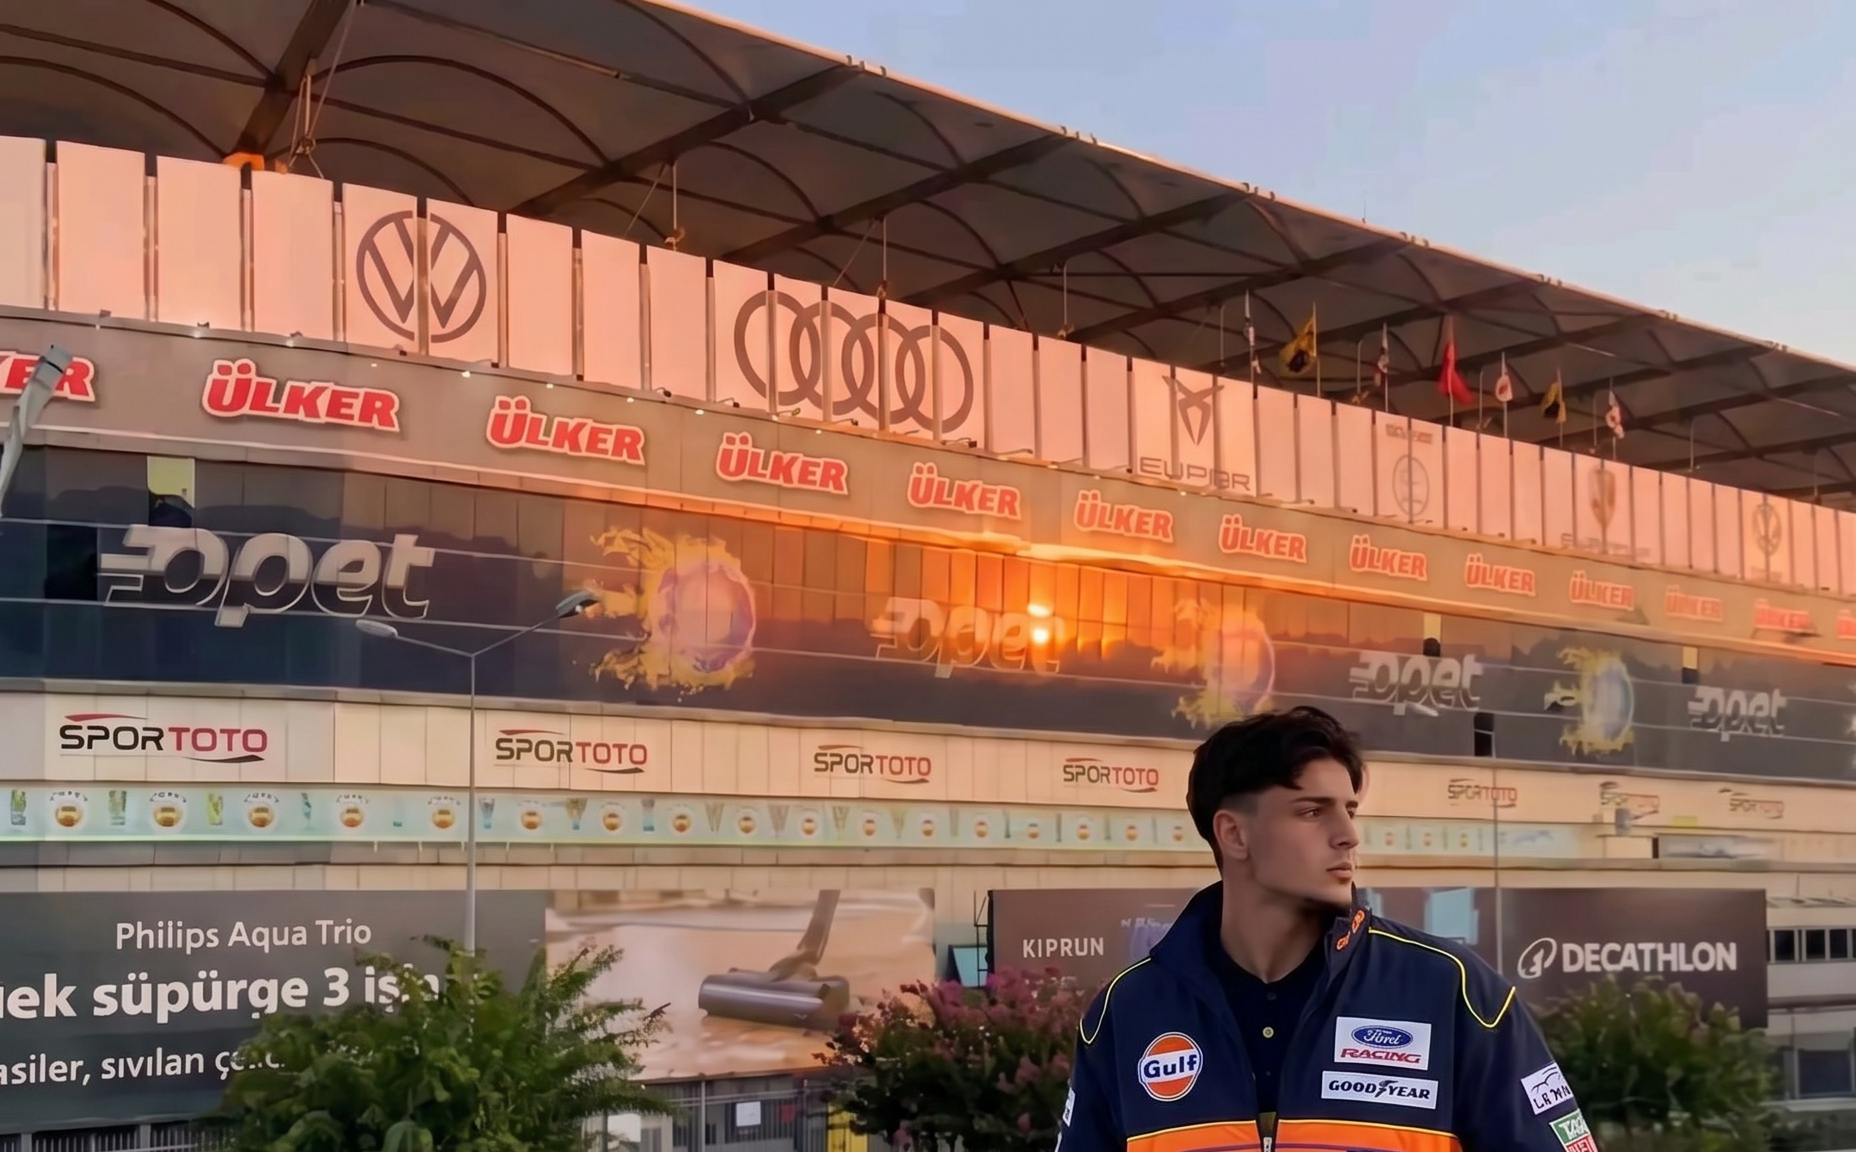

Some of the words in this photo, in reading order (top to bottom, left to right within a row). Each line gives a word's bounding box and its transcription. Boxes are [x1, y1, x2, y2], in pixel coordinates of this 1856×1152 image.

[0, 355, 91, 399] ER
[205, 360, 398, 430] ÜLKER
[488, 397, 644, 463] ÜLKER
[717, 434, 847, 493] ÜLKER
[909, 463, 1020, 518] ÜLKER
[1075, 491, 1172, 541] ÜLKER
[1220, 515, 1305, 561] ÜLKER
[1351, 536, 1426, 580] ÜLKER
[1465, 554, 1535, 595] ÜLKER
[116, 920, 219, 955] Philips
[228, 921, 307, 953] Aqua
[315, 918, 372, 945] Trio
[1023, 937, 1104, 958] KIPRUN
[1562, 941, 1737, 972] DECATHLON
[0, 973, 77, 1019] ek
[93, 970, 309, 1024] süpürge
[323, 967, 349, 1007] 3
[101, 1046, 204, 1080] sıvılan
[1143, 1054, 1198, 1078] Gulf
[1340, 1048, 1422, 1064] RACING
